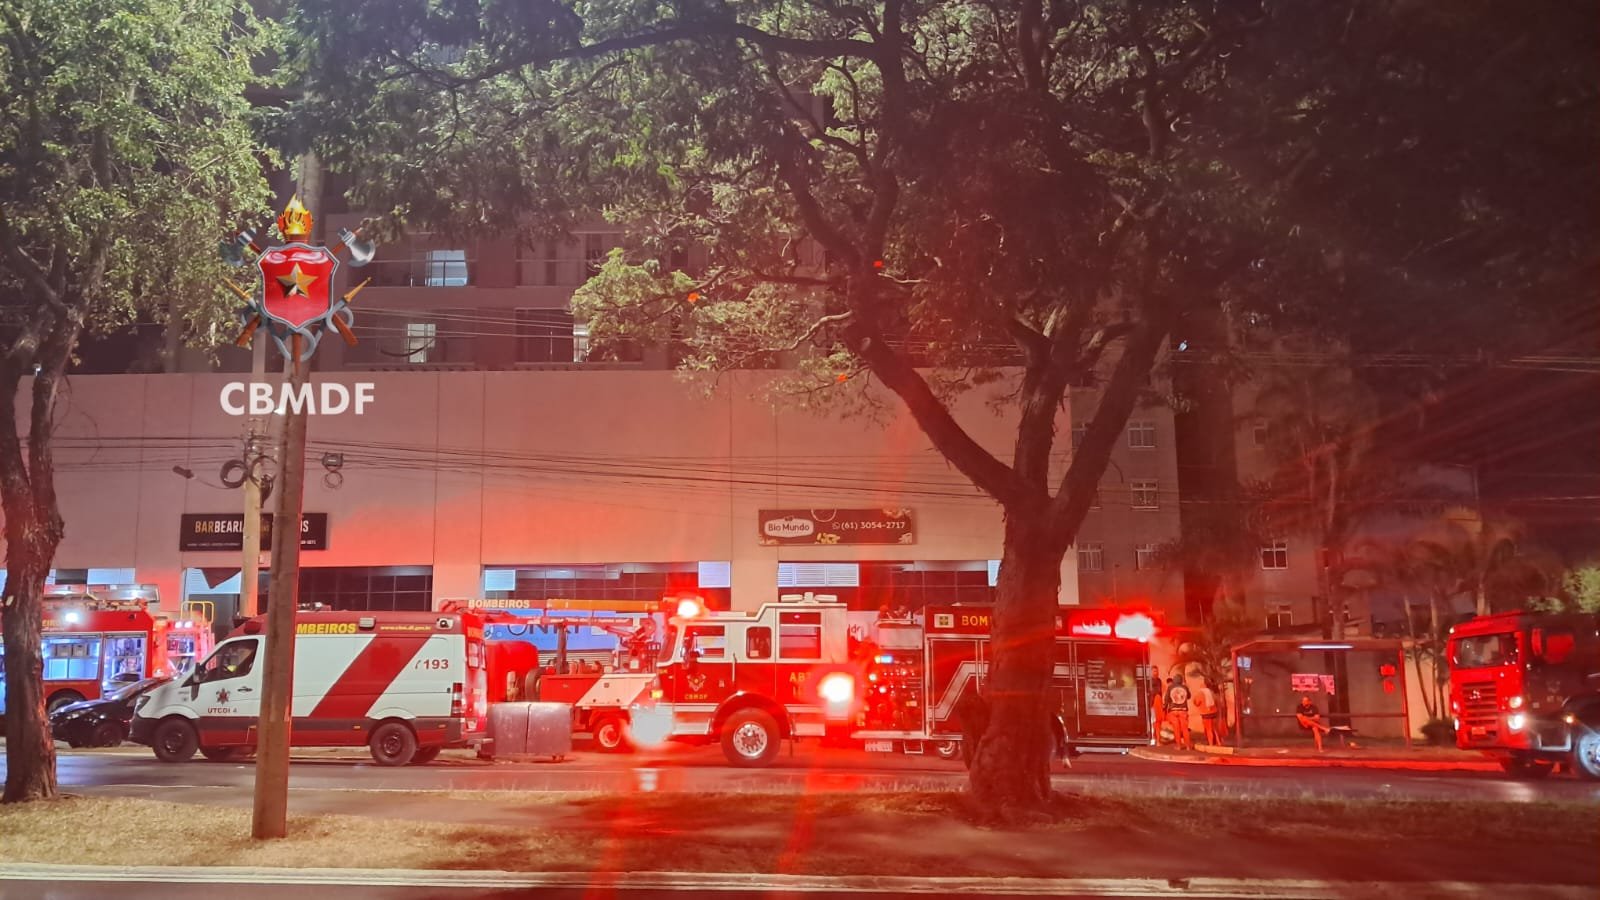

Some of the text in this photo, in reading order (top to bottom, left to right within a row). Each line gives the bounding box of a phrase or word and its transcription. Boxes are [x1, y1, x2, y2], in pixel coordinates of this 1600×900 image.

[195, 520, 244, 533] BARBEARI
[768, 522, 810, 532] Bio Mundo
[841, 522, 858, 531] (61)
[468, 599, 530, 609] BOMBEIROS
[961, 615, 992, 626] BOM
[295, 623, 357, 634] MBEIROS
[422, 659, 449, 669] 193
[1091, 691, 1113, 700] 20%
